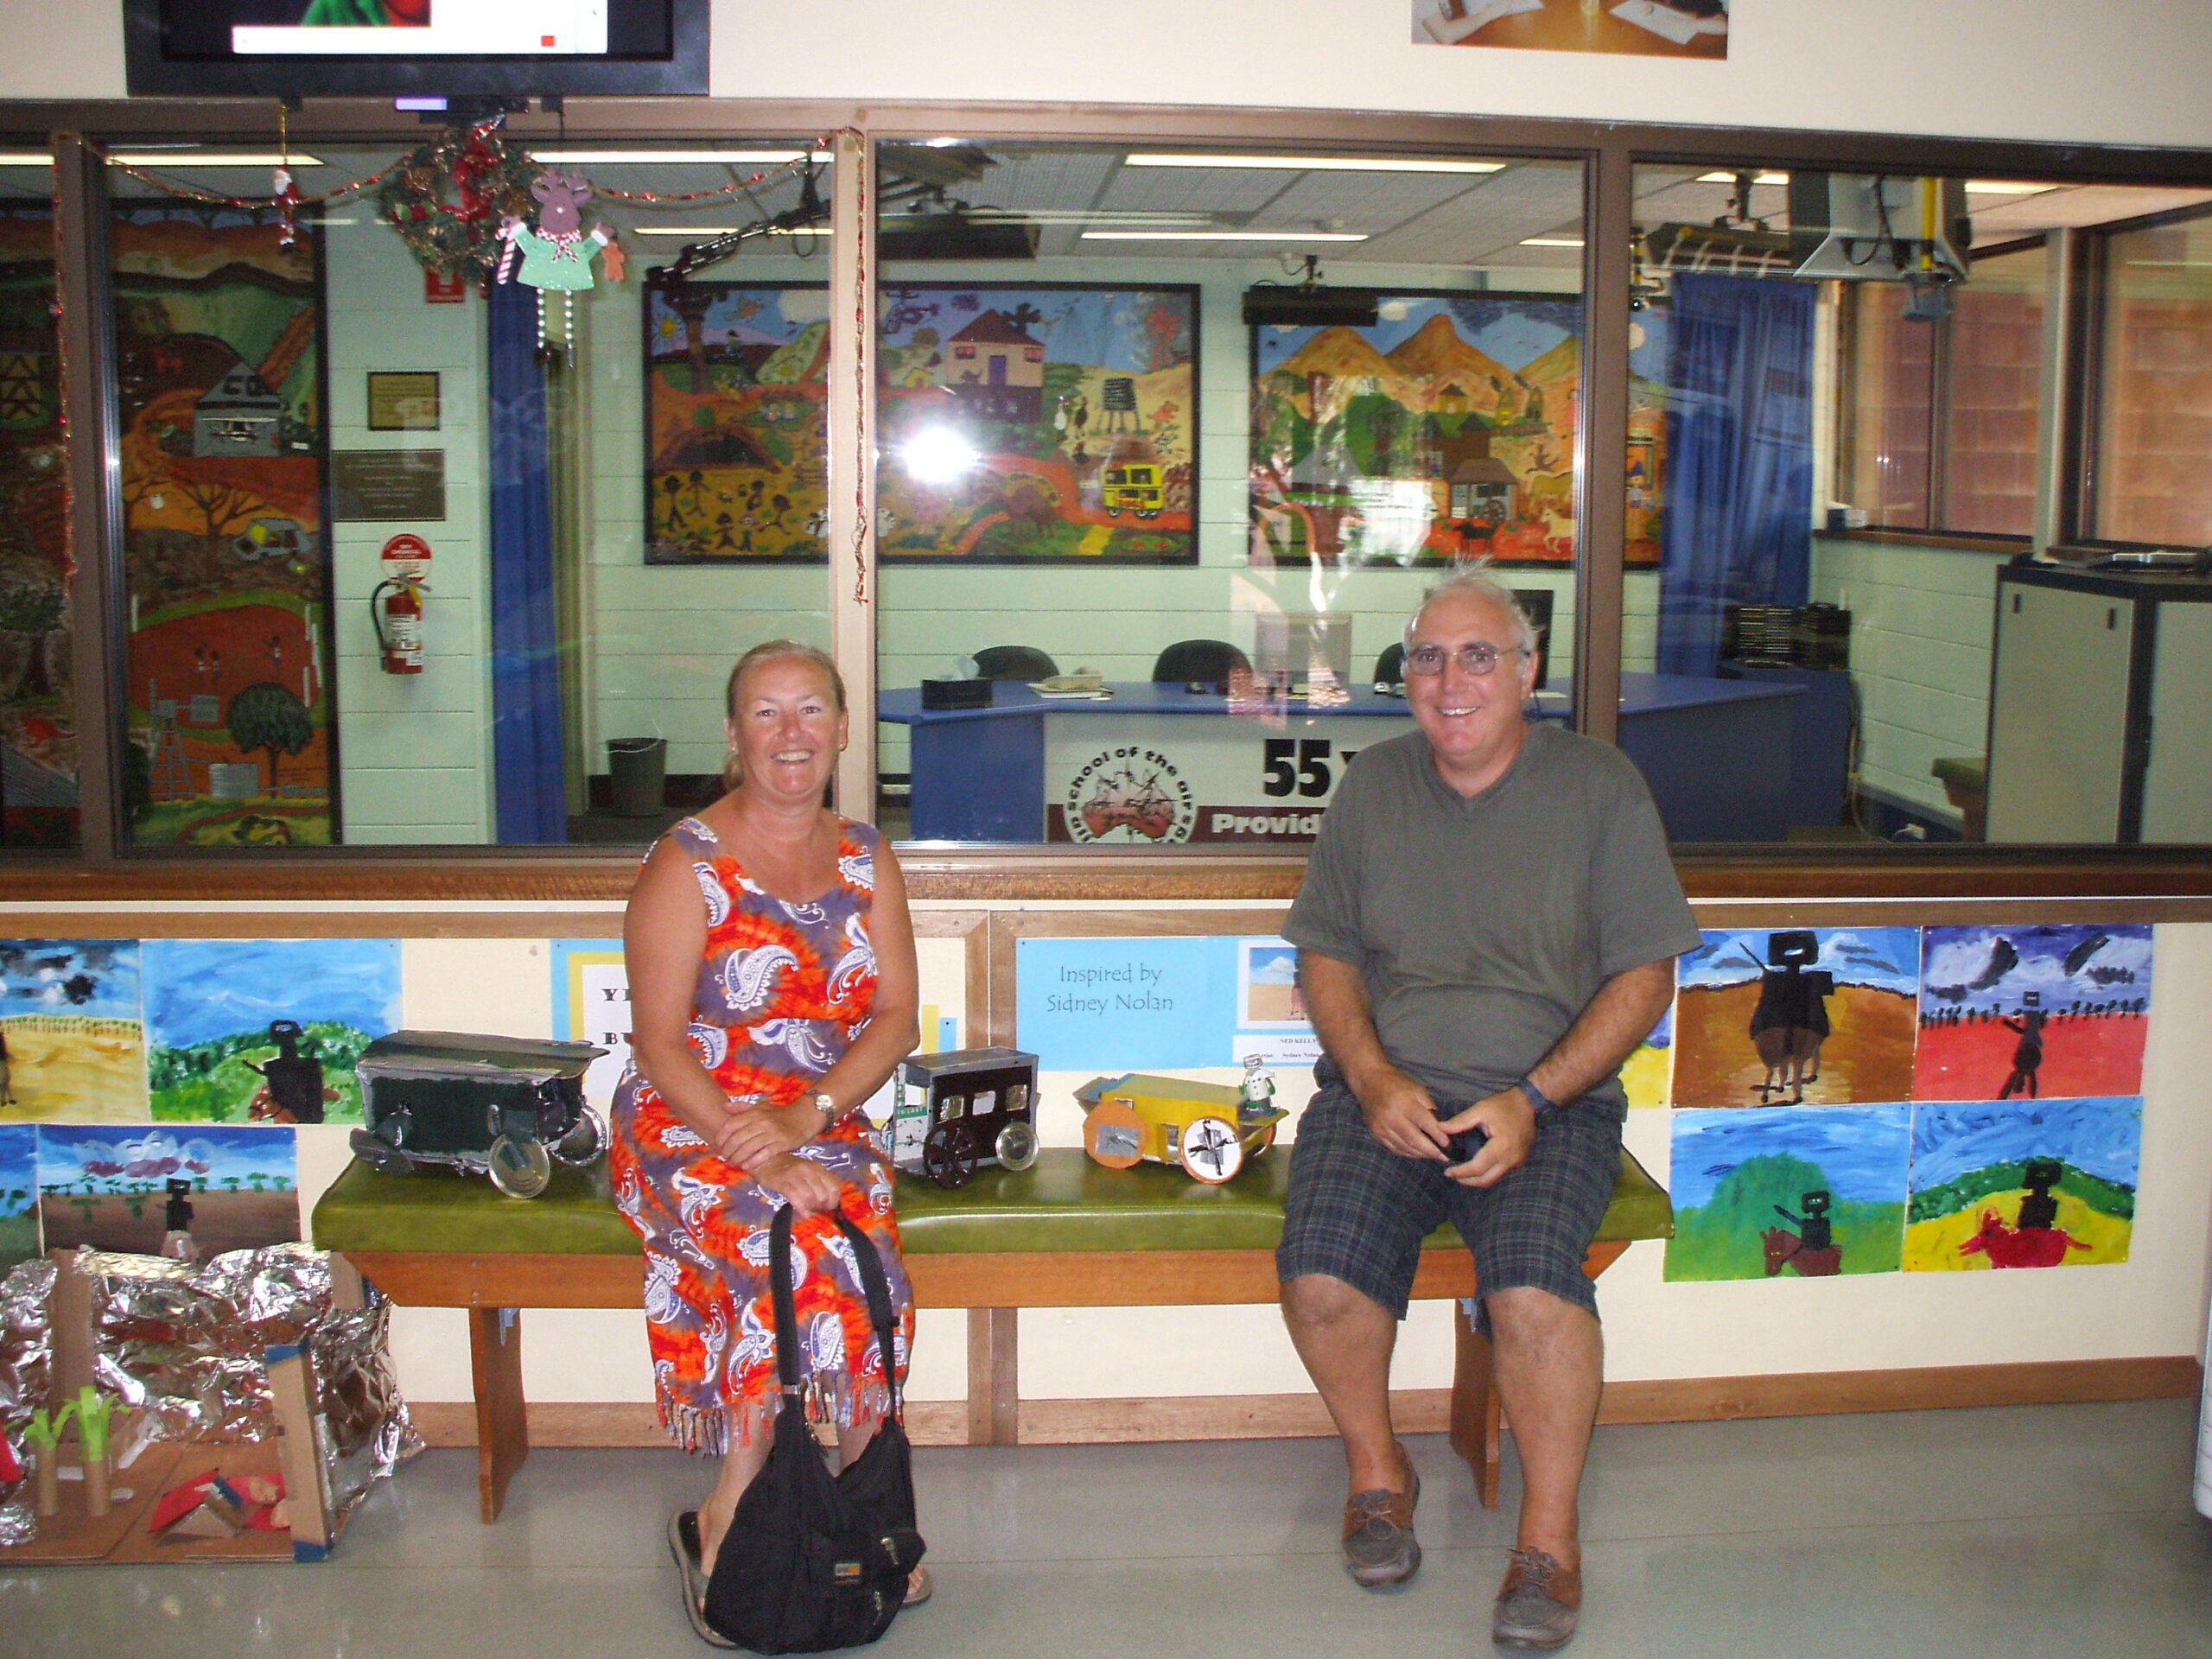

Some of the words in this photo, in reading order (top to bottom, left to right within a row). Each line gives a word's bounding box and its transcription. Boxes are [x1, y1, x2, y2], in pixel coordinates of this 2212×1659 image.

[1067, 752, 1110, 811] school
[1115, 747, 1140, 758] of
[1145, 750, 1178, 777] the
[1177, 780, 1192, 810] air
[1264, 739, 1331, 798] 55
[1212, 813, 1325, 834] Provid
[1060, 963, 1133, 987] Inspired
[1140, 963, 1162, 987] by
[1046, 993, 1108, 1016] Sidney
[1116, 990, 1173, 1011] Nolan
